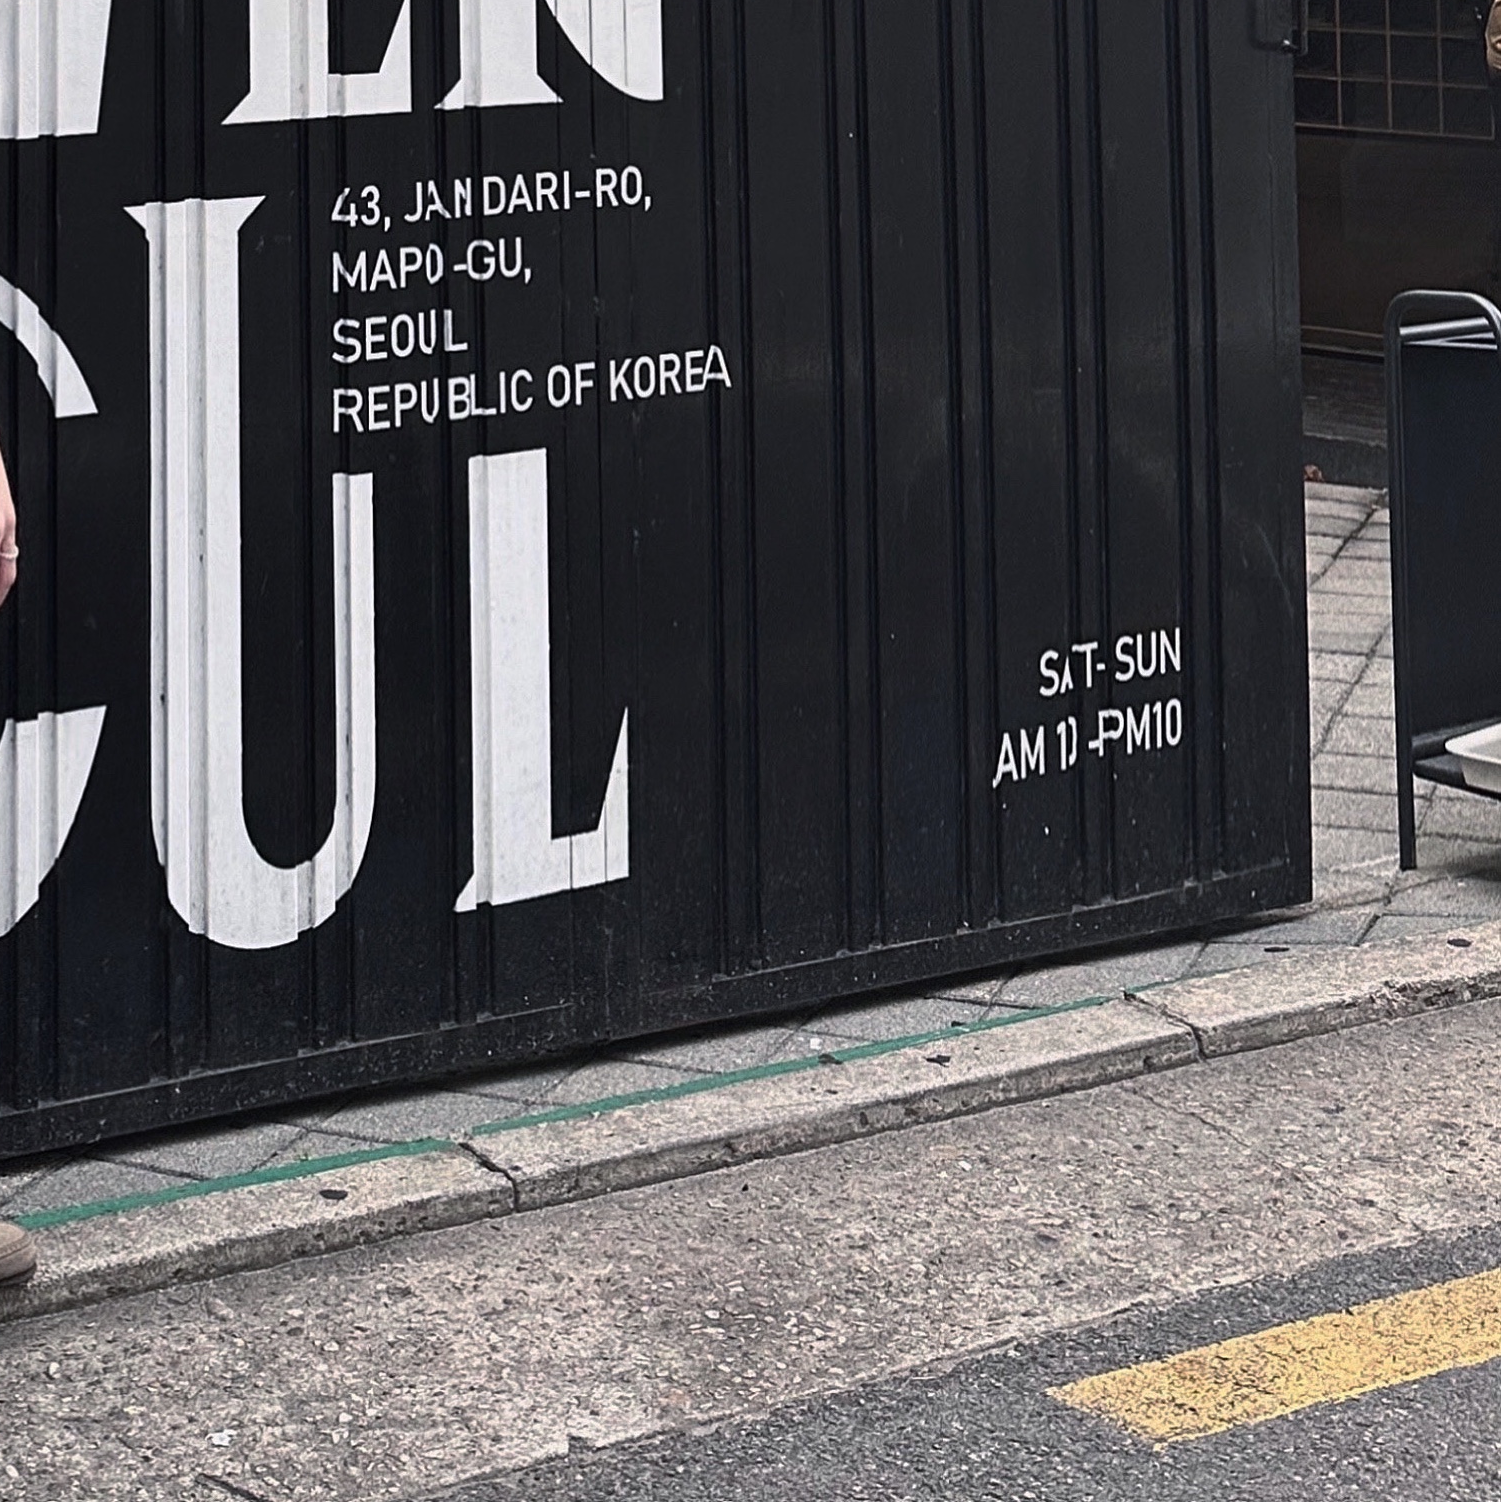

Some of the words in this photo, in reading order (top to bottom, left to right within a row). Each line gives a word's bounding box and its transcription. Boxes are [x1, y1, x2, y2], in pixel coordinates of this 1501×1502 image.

[331, 185, 392, 232] 43,
[332, 236, 533, 293] MAPO-GU,
[331, 308, 468, 364] SEOUL
[333, 368, 534, 433] REPUBLIC
[547, 361, 596, 408] OF
[609, 344, 732, 402] KOREA
[992, 725, 1046, 789] AM
